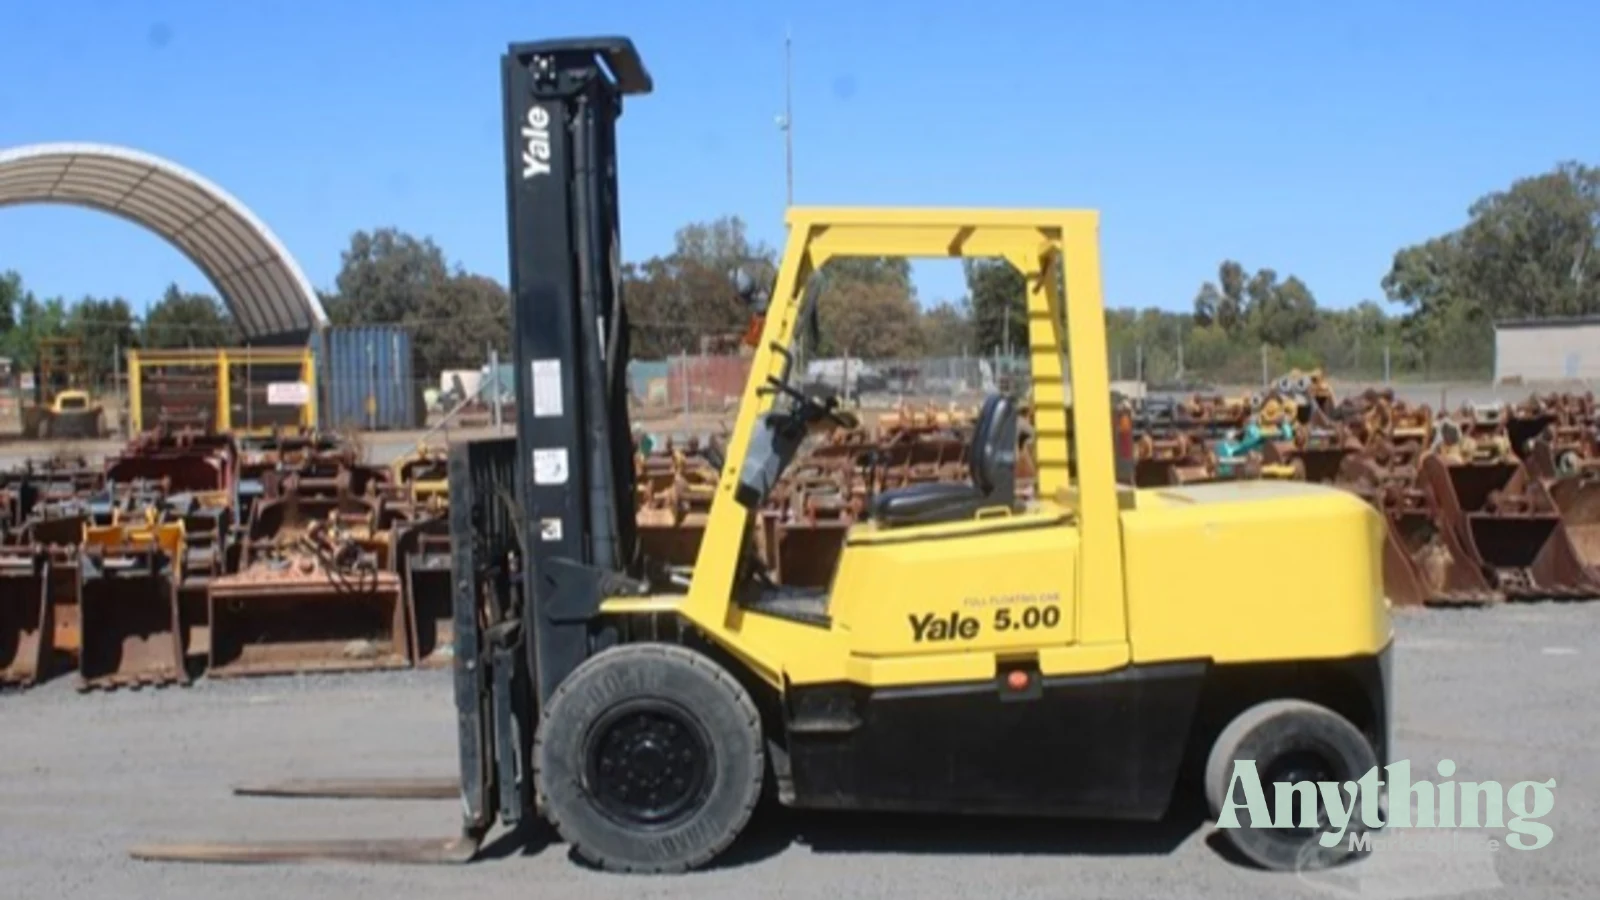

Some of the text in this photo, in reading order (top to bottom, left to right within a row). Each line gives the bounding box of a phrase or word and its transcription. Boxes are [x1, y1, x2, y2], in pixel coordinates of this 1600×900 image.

[522, 106, 550, 178] Yale
[908, 605, 1060, 642] Yale 5.00
